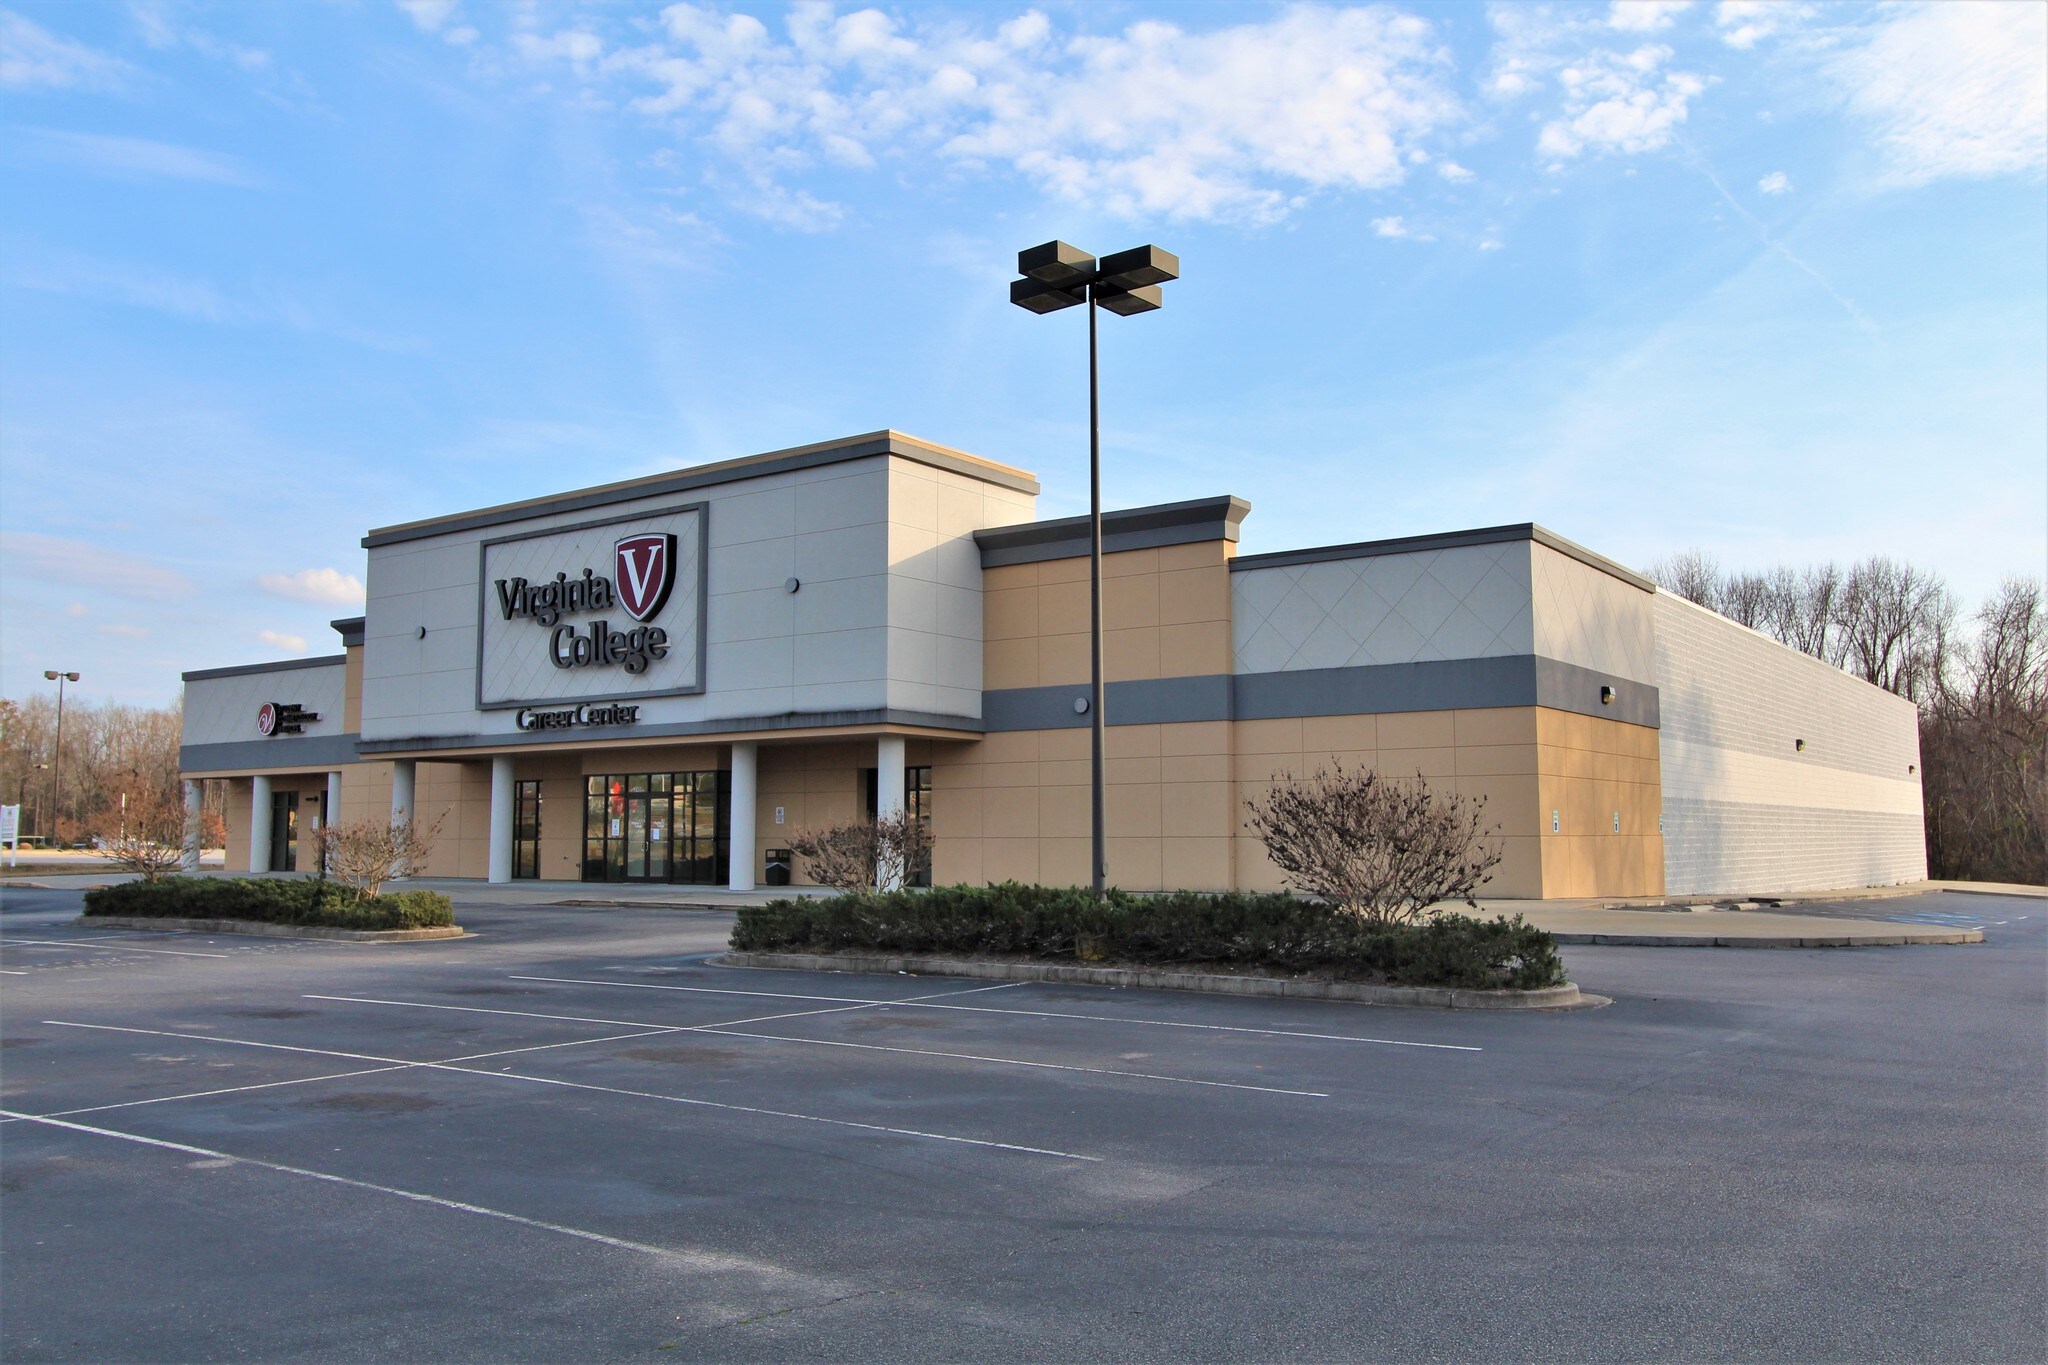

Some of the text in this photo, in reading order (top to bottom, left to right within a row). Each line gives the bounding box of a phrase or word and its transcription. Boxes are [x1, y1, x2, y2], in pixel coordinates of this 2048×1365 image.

[495, 569, 613, 626] Virginia
[619, 545, 662, 608] V
[550, 620, 668, 674] College
[516, 703, 640, 731] Career Center
